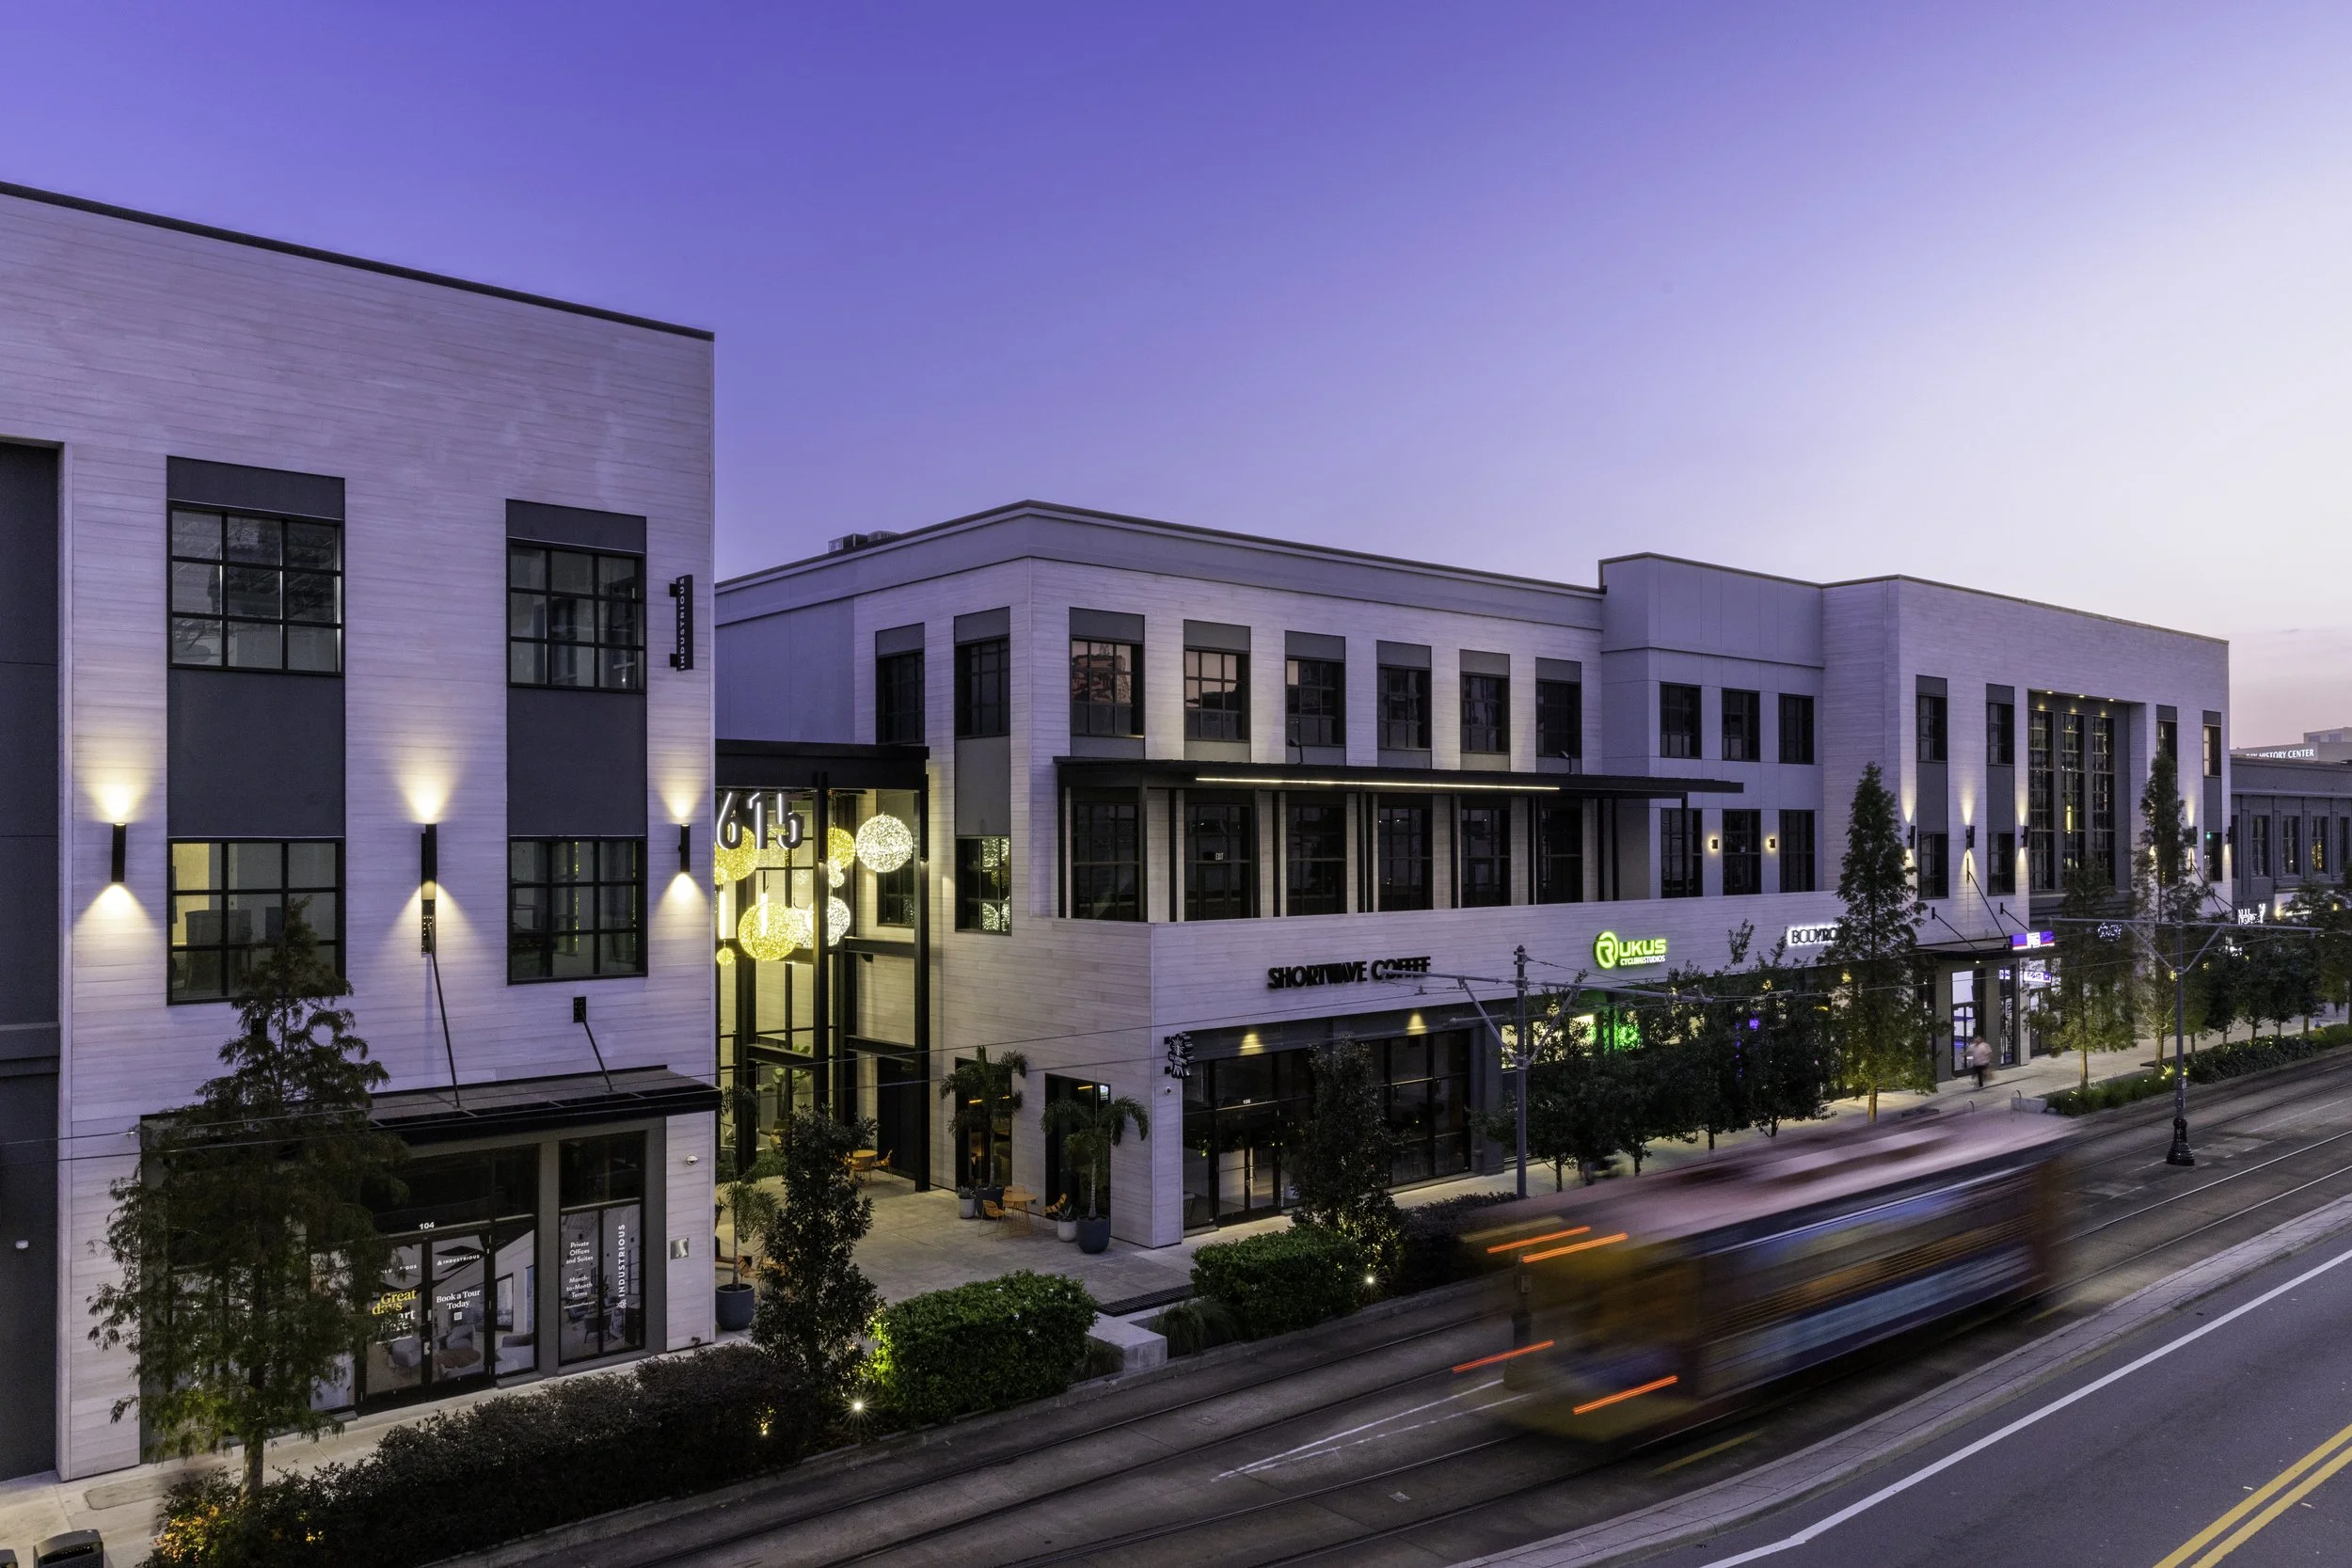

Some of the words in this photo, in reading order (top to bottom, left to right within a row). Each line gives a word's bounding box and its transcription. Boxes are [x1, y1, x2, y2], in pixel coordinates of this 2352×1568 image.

[2287, 749, 2314, 758] CENTER
[717, 792, 804, 849] 615
[1791, 927, 1837, 943] BODYRO
[1267, 960, 1367, 989] SHORTWAVE
[1371, 956, 1431, 980] COFFEE
[419, 1222, 435, 1230] 104
[569, 1248, 590, 1257] Offices
[380, 1290, 417, 1306] Great
[436, 1293, 456, 1304] Book
[462, 1290, 481, 1298] Tour
[446, 1300, 470, 1310] Today
